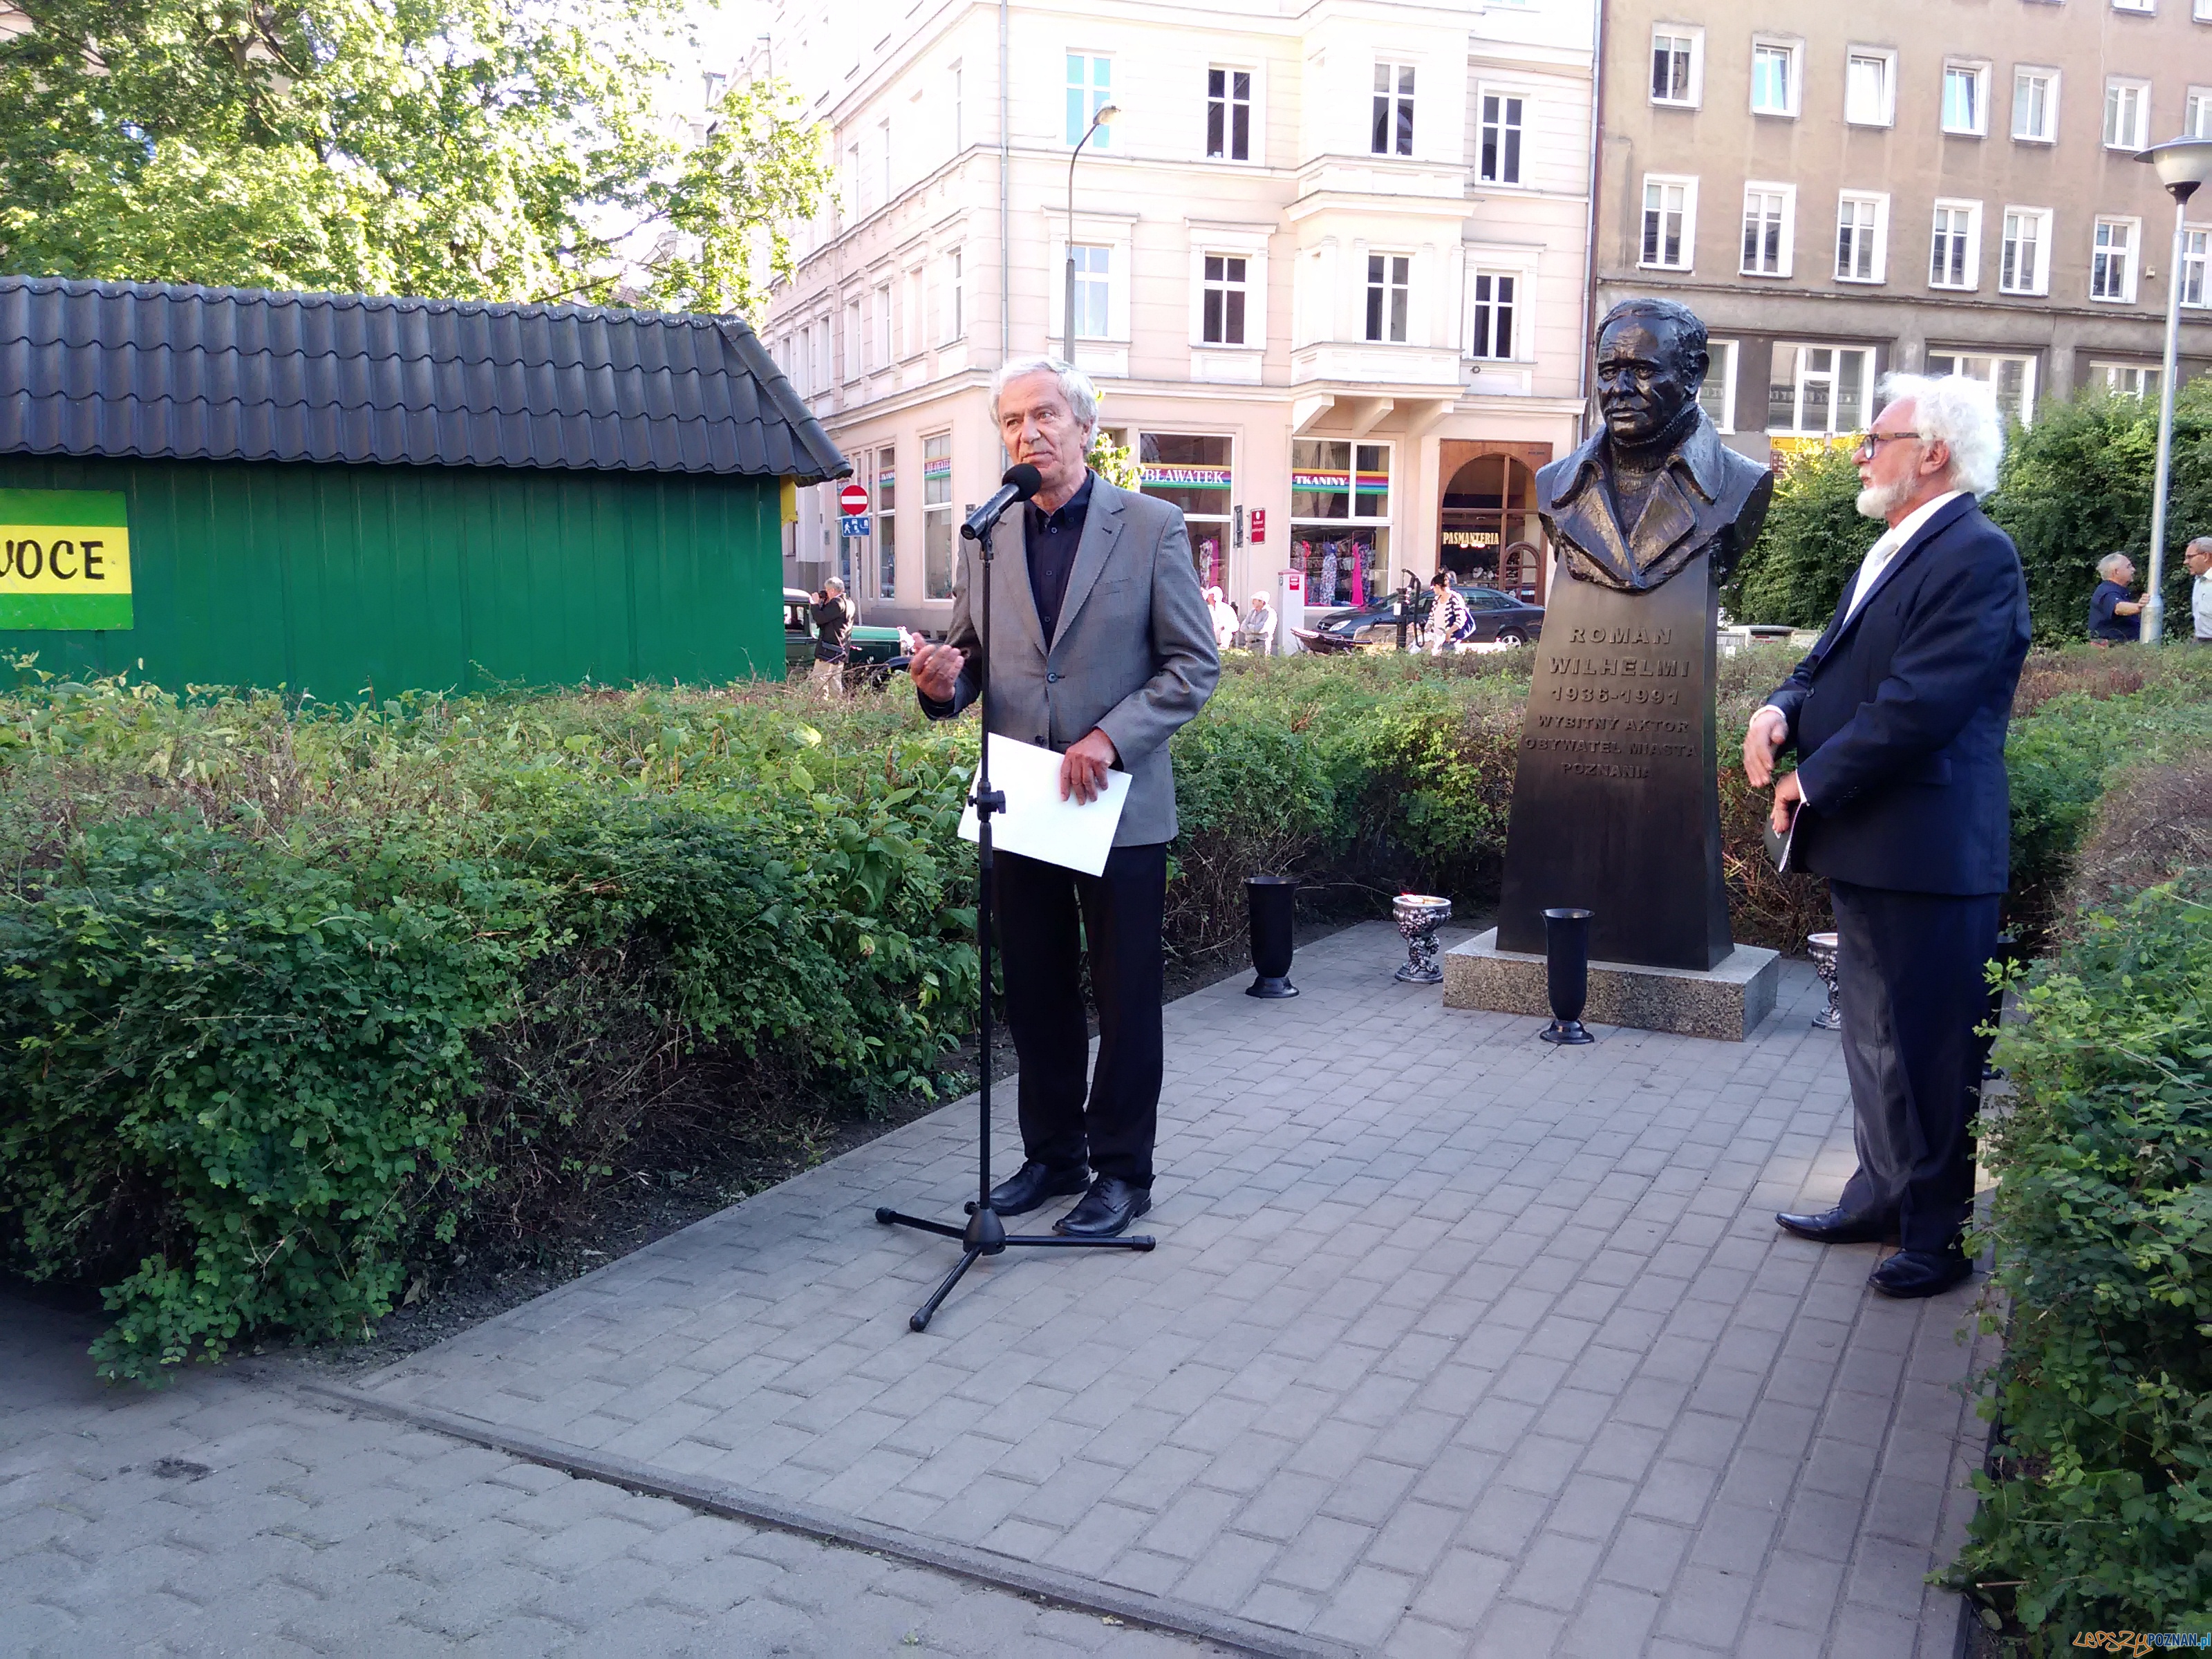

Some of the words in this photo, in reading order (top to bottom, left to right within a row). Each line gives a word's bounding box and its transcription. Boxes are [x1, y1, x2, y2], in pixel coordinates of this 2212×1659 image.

[1144, 469, 1225, 484] BŁAWATEK
[1295, 476, 1347, 486] TKANINY
[1443, 532, 1499, 545] PASMANTERIA
[1569, 626, 1672, 644] ROMAN
[1548, 657, 1690, 677] WILHELMI
[1552, 686, 1679, 705] 1936-1991
[1538, 715, 1619, 731] WYBITNY
[1624, 719, 1689, 733] AKTOR
[1524, 738, 1622, 754] OBYWATEL
[1629, 743, 1697, 757] MIASTA
[1561, 762, 1654, 778] POZNANIA
